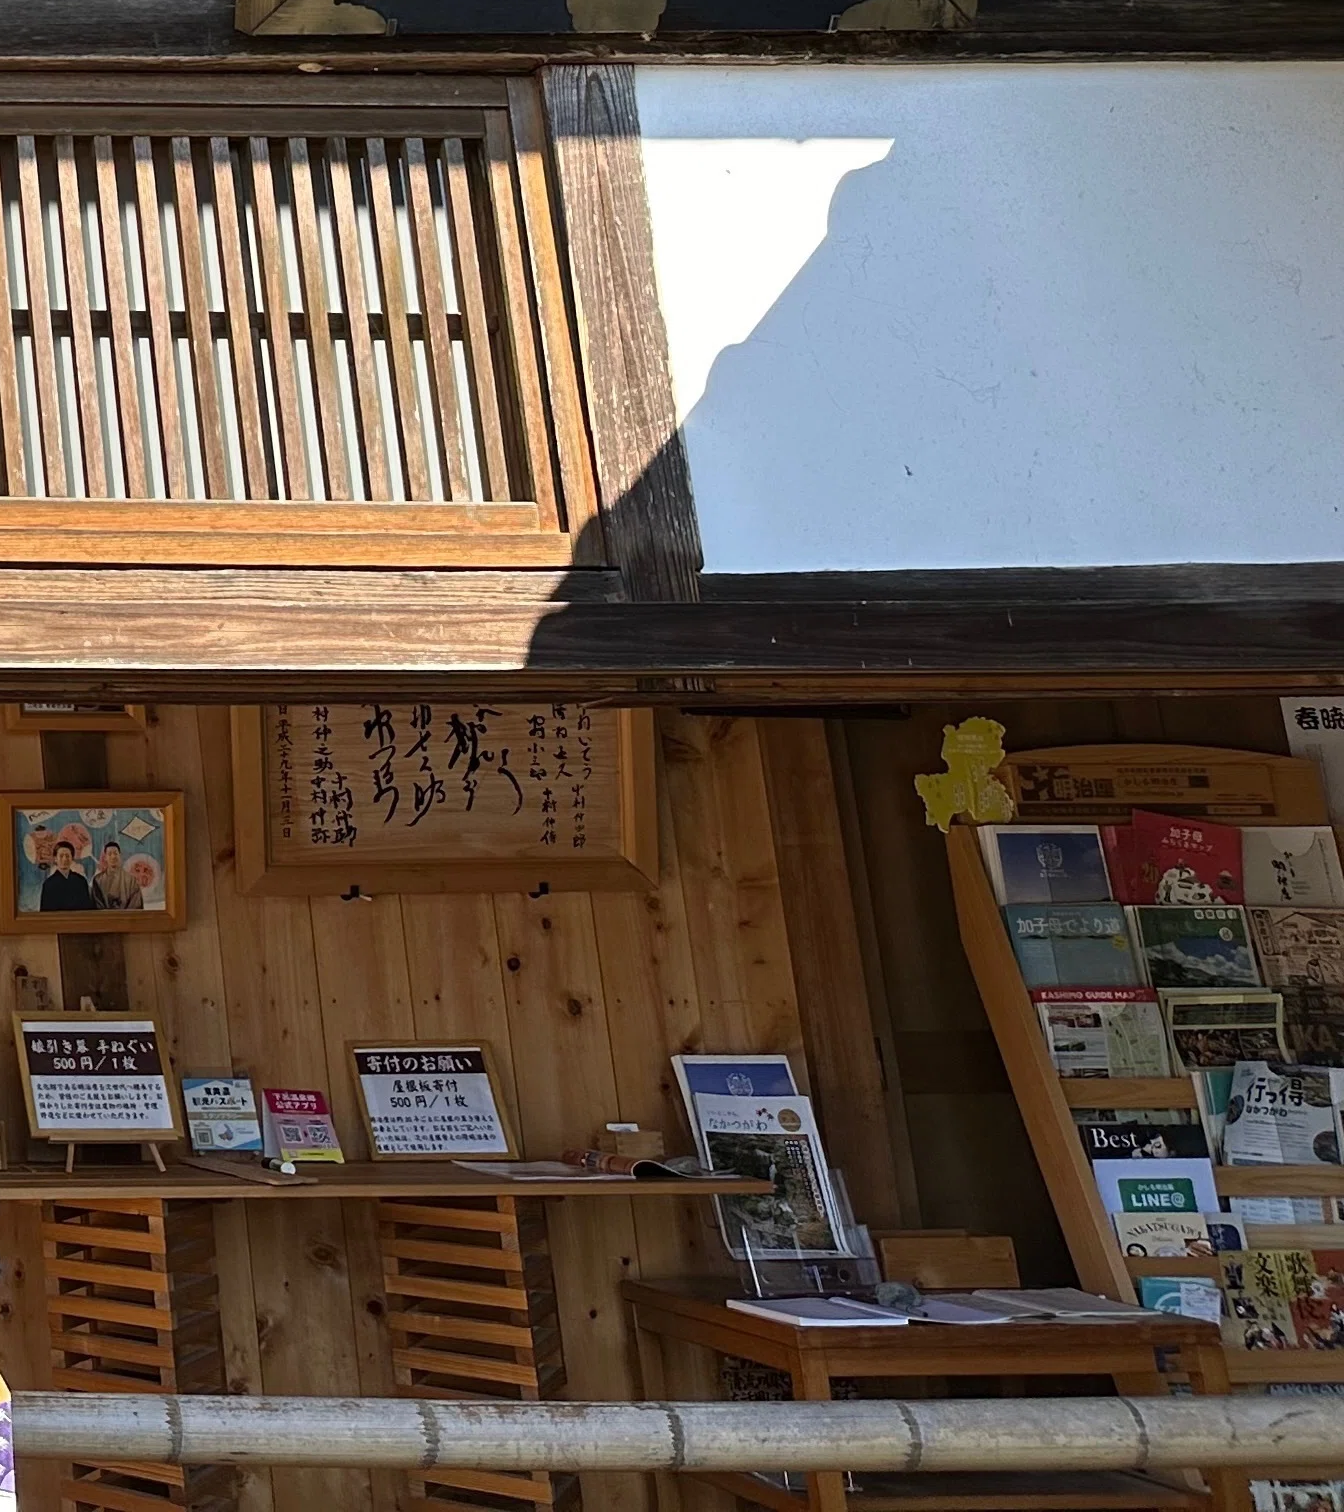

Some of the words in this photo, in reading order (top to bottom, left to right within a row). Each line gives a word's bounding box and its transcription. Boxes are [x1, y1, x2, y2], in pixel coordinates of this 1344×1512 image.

[1169, 827, 1204, 843] 加子母
[1041, 991, 1083, 1001] KASHIMO
[1085, 991, 1112, 1001] GUIDE
[1115, 991, 1136, 1001] MAP
[97, 1038, 154, 1055] 手ぬぐい
[366, 1054, 473, 1072] 寄付のお願い
[393, 1079, 458, 1093] 屋根板寄付
[1246, 1105, 1288, 1117] なかつがわ
[1090, 1127, 1140, 1149] Best
[1131, 1192, 1186, 1208] LINE@
[1255, 1252, 1279, 1297] 文楽
